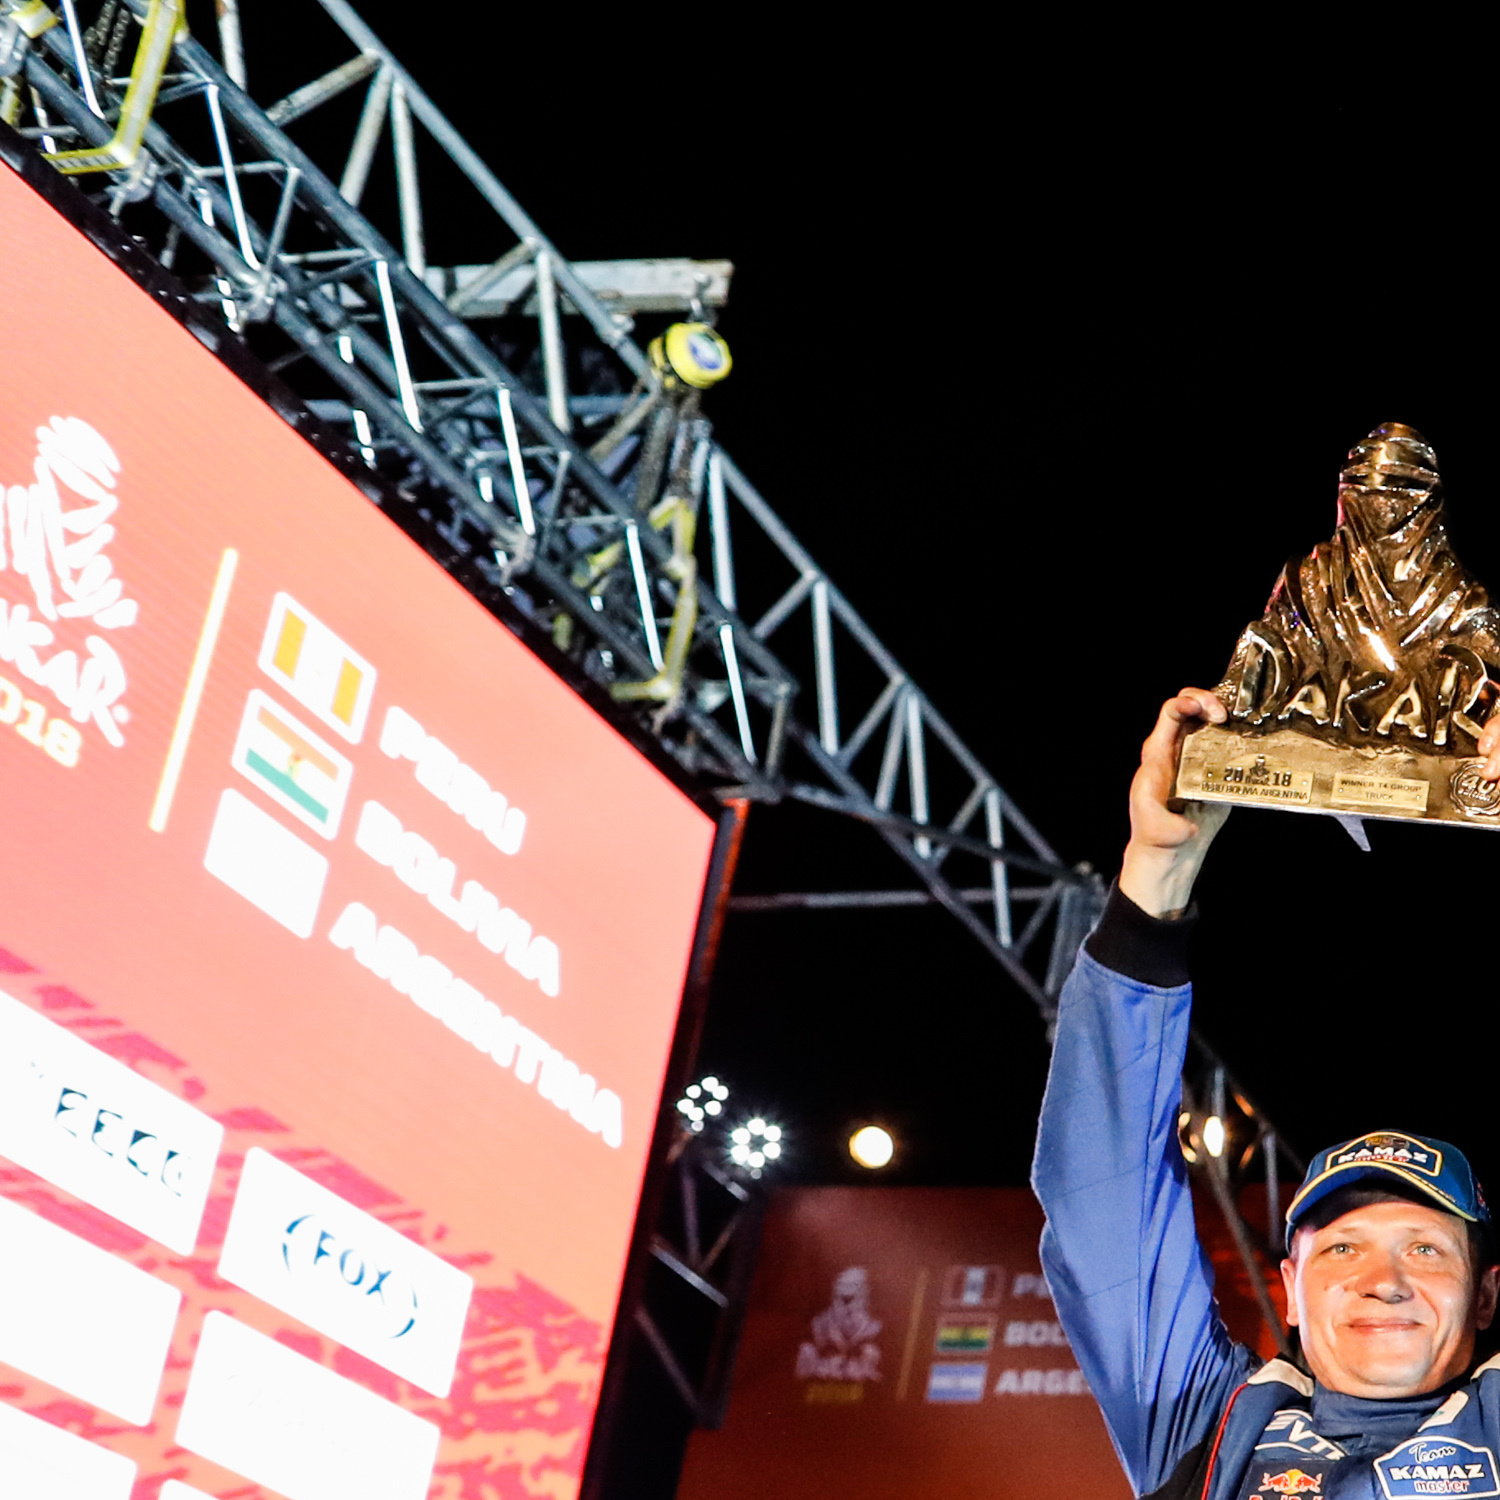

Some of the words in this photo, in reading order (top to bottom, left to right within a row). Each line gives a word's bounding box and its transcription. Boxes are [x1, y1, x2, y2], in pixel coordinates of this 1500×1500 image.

[0, 676, 82, 768] 018
[1259, 787, 1308, 800] ARGENTINA
[1340, 779, 1375, 789] WINNER
[1390, 783, 1422, 793] GROUP
[1365, 791, 1394, 801] TRUCK
[1337, 1146, 1429, 1164] KAMAZ
[994, 1368, 1094, 1395] ARGE
[1409, 1441, 1457, 1465] Team
[1389, 1464, 1485, 1481] KAMAZ
[1414, 1478, 1470, 1494] master
